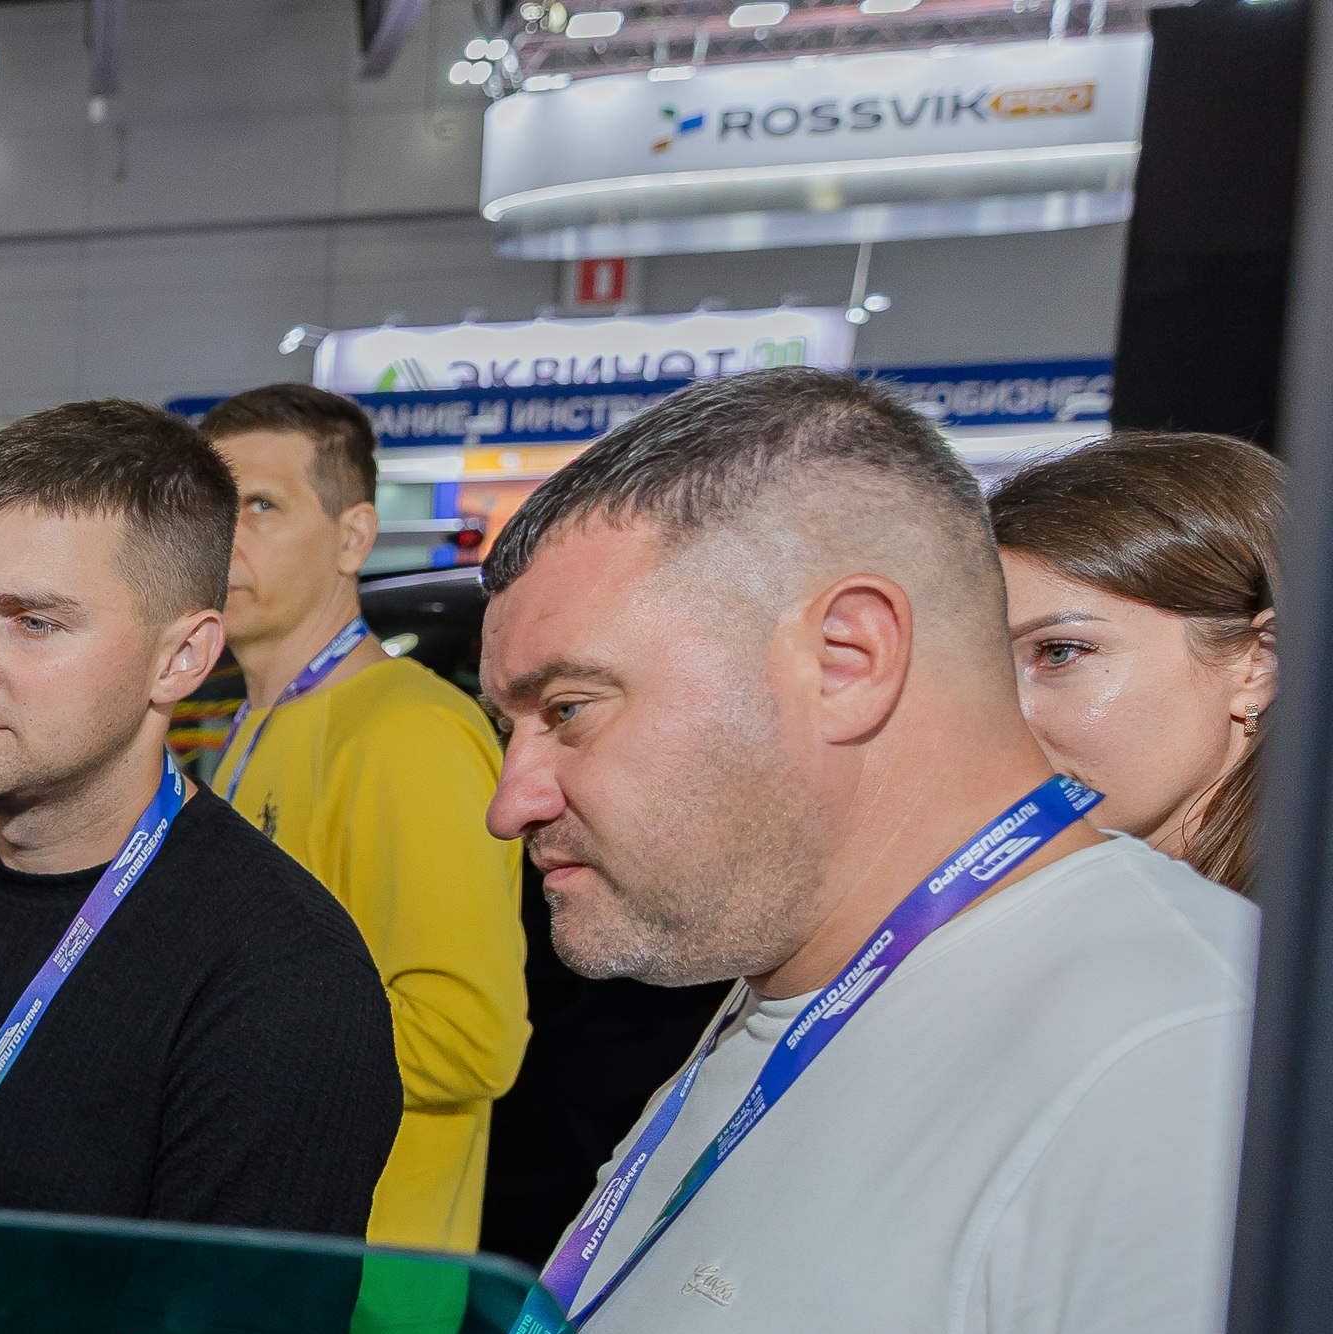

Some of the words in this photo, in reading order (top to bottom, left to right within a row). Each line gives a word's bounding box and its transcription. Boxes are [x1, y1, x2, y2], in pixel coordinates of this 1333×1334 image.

[719, 88, 990, 141] ROSSVIK
[113, 818, 170, 898] AUTOBUSEXPO
[928, 801, 1041, 896] AUTOBUSEXPO
[786, 929, 896, 1051] COMAUTOTRANS
[581, 1152, 647, 1262] AUTOBUSEXPO
